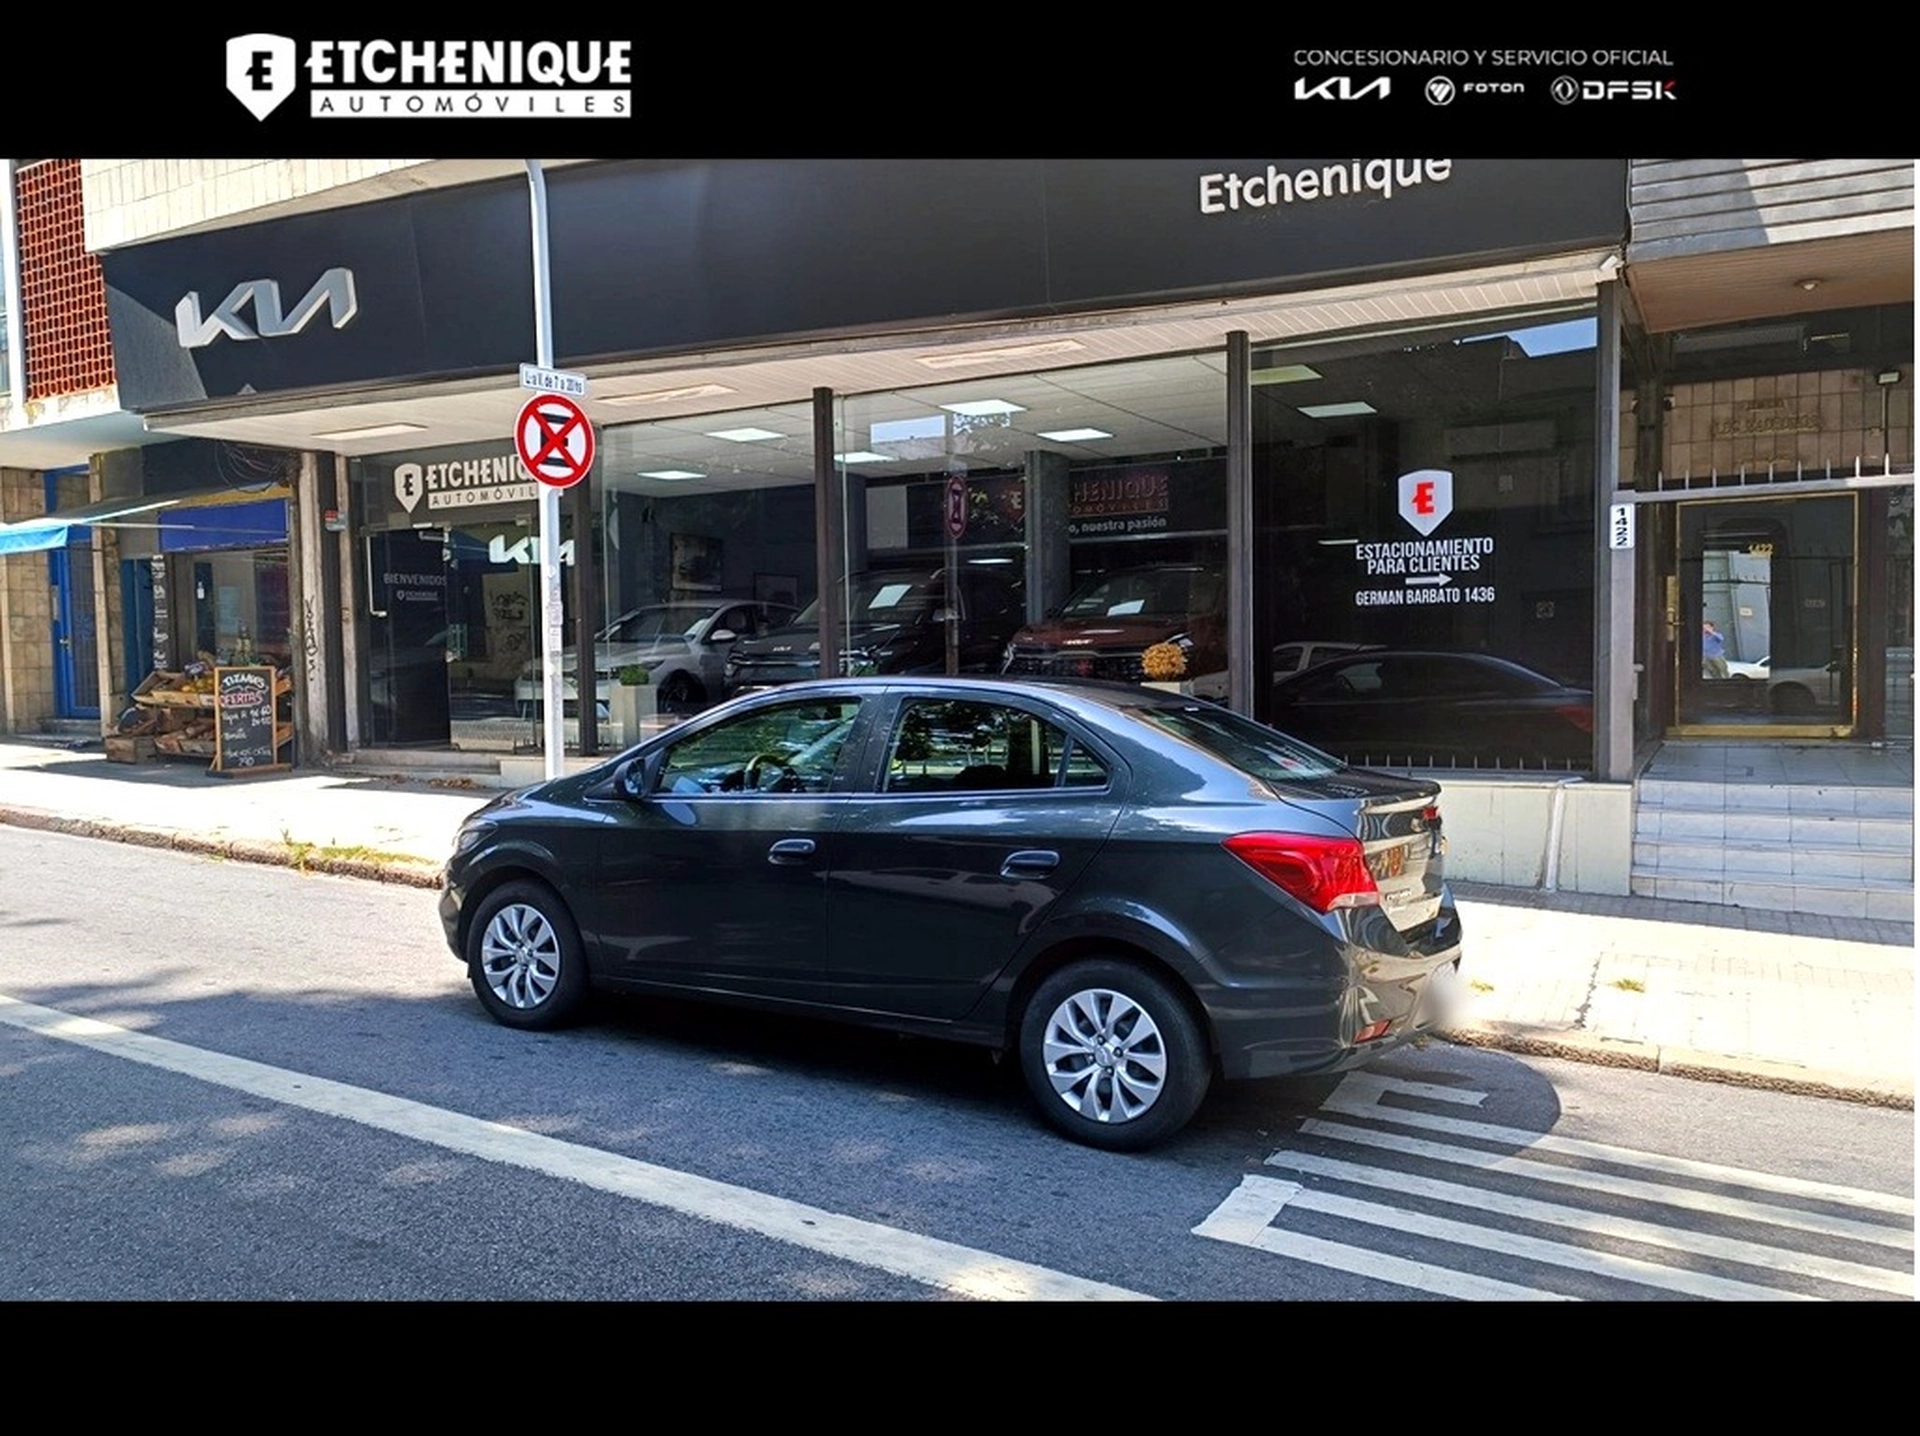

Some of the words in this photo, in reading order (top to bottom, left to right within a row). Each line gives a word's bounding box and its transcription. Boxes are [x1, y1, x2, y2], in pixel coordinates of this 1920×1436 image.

[1200, 159, 1451, 214] Etchenique
[175, 267, 357, 349] KIA
[426, 454, 534, 490] ETCHENIQ
[431, 487, 535, 506] AUTOMÓVIL
[1074, 475, 1168, 502] HENIQUE
[1072, 499, 1165, 515] OMÓVILES
[1081, 520, 1125, 532] nuestra
[1127, 516, 1167, 532] pasión
[1615, 507, 1628, 546] 1422
[1356, 537, 1494, 560] ESTACIONAMIENTO
[1367, 558, 1406, 575] PARA
[1408, 554, 1480, 574] CLIENTES
[383, 573, 447, 586] BIENVENIDOS
[1355, 589, 1404, 606] GERMAN
[1405, 588, 1460, 604] BARBATO
[1464, 586, 1495, 602] 1436
